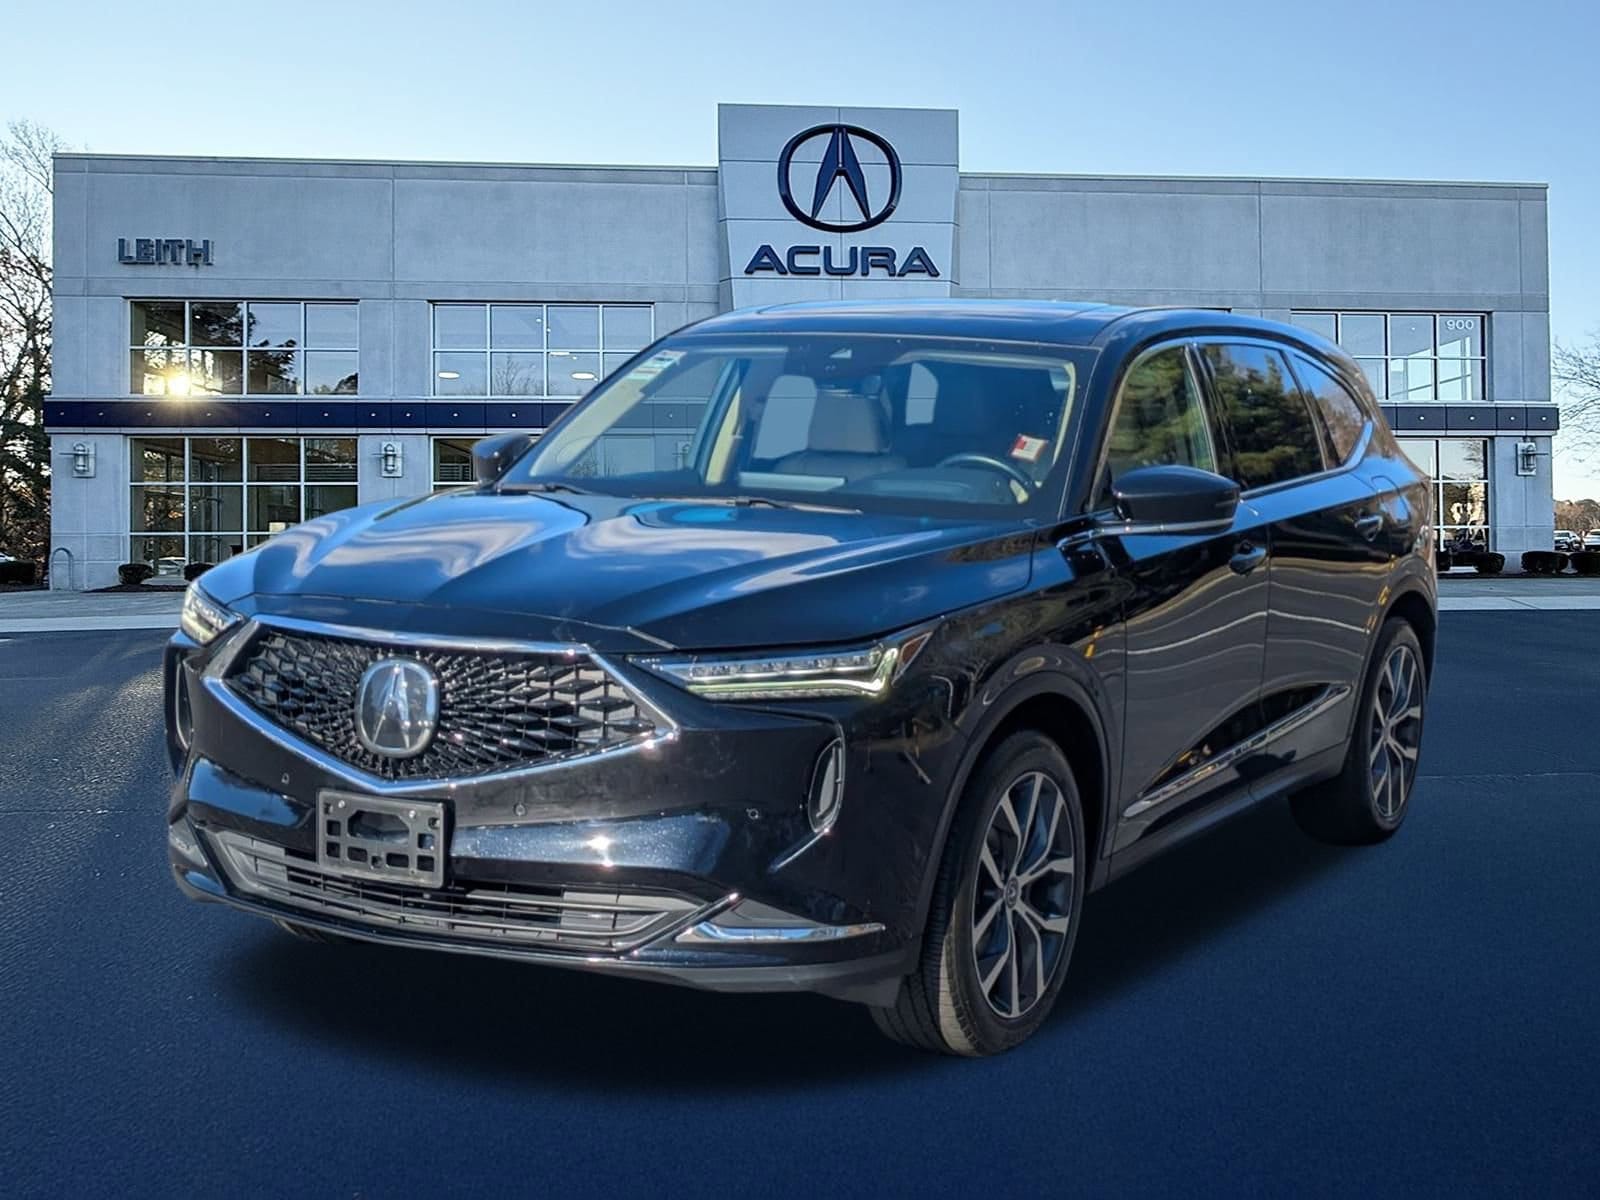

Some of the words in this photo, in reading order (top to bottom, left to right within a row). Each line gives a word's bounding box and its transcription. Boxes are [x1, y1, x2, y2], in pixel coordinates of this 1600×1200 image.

[118, 238, 213, 265] LEITH
[744, 244, 940, 277] ACURA
[1446, 319, 1474, 330] 900
